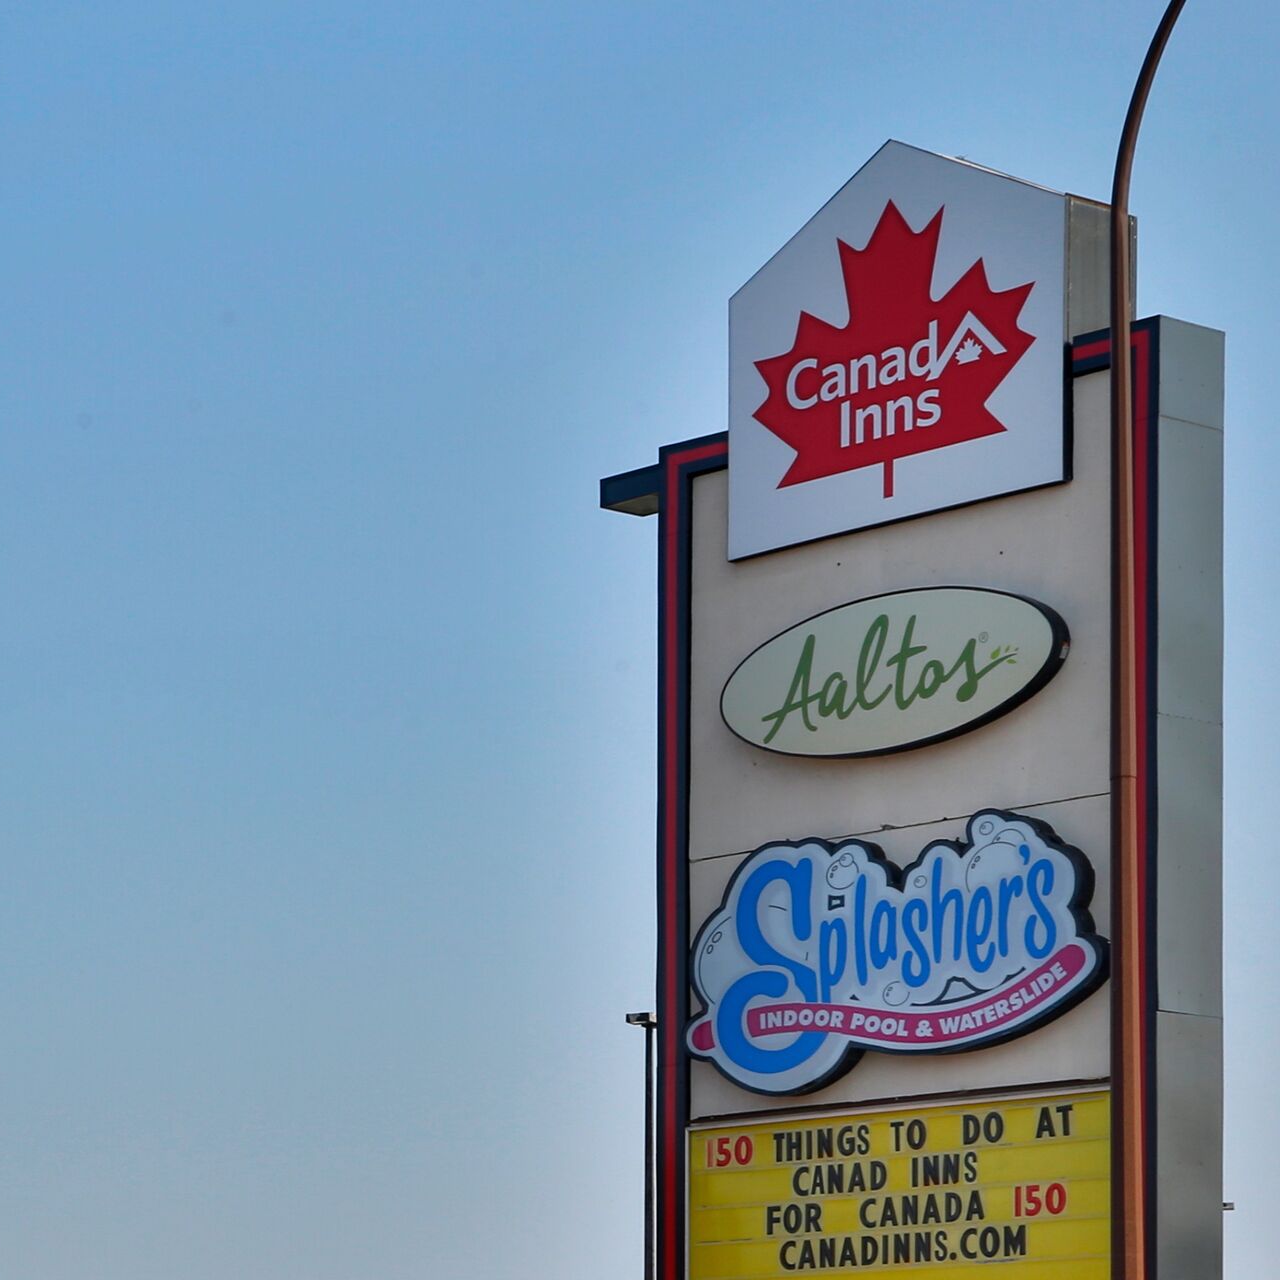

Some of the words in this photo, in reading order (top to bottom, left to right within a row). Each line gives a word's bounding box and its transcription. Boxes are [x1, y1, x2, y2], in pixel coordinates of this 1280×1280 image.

[840, 389, 942, 449] Inns
[761, 614, 1017, 744] Aaltos
[717, 843, 1057, 1074] Splasher's
[759, 1010, 844, 1030] INDOOR
[850, 1014, 908, 1037] POOL
[915, 1020, 934, 1038] &
[940, 961, 1067, 1036] WATERSLIDE
[706, 1135, 754, 1168] 150
[773, 1124, 870, 1163] THINGS
[890, 1119, 926, 1151] TO
[962, 1111, 1004, 1146] DO
[1035, 1104, 1073, 1139] AT
[792, 1160, 887, 1197] CANAD
[911, 1151, 977, 1188] INNS
[766, 1203, 822, 1236] FOR
[859, 1190, 985, 1229] CANADA
[1014, 1182, 1067, 1218] 150
[779, 1225, 1027, 1271] CANADINNS.COM
